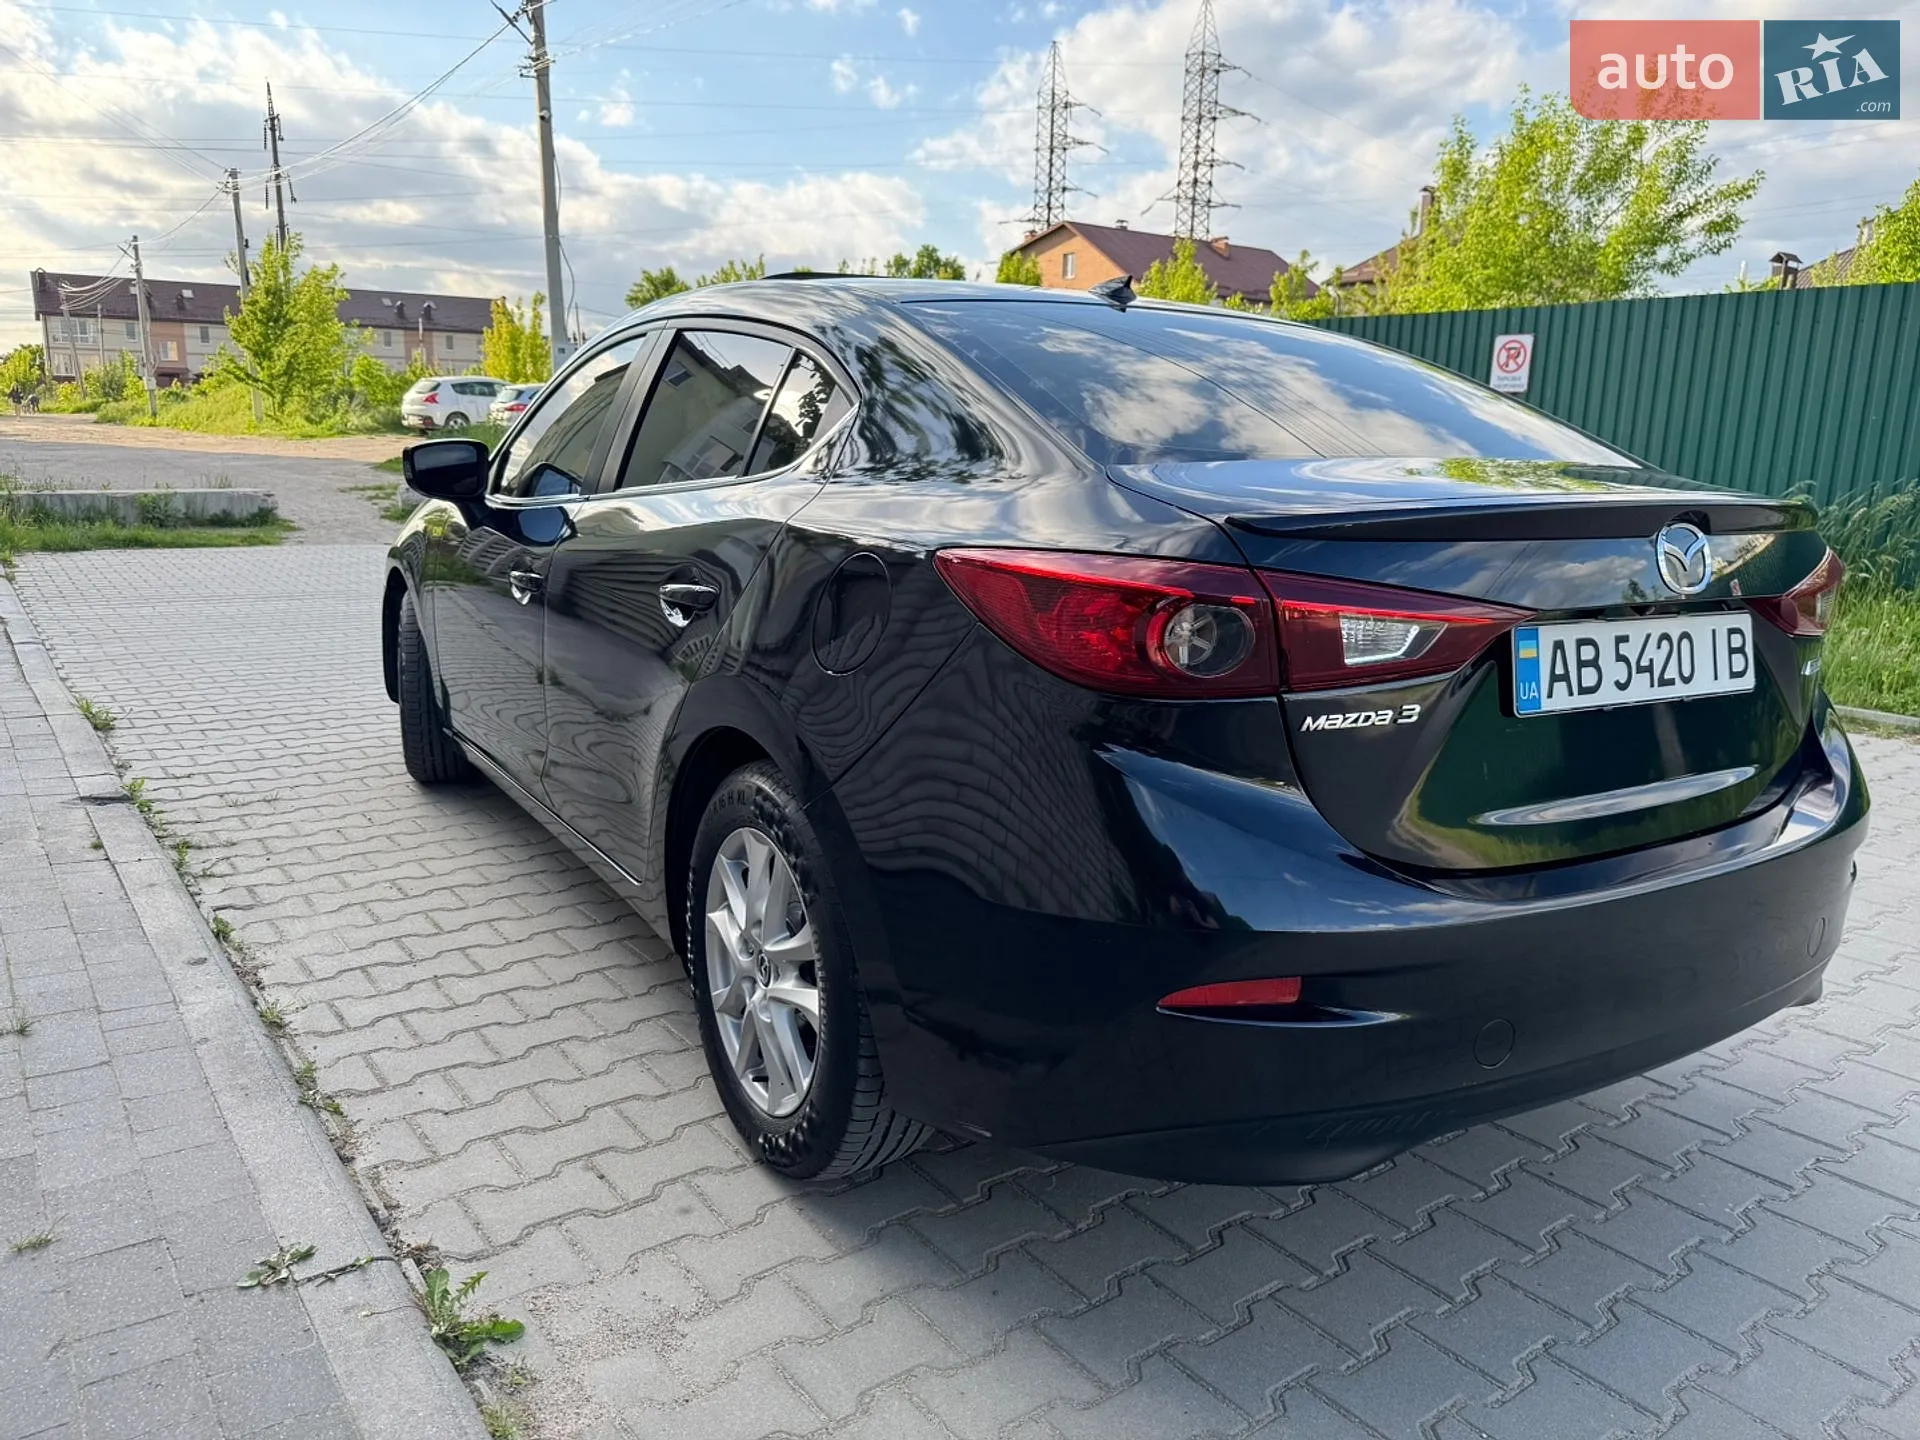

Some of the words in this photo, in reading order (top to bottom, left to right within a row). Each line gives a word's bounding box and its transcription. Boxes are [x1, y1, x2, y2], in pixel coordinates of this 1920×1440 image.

[1547, 637, 1603, 699] AB
[1613, 631, 1696, 691] 5420
[1712, 627, 1750, 682] IB
[1519, 682, 1539, 700] UA
[1396, 703, 1422, 724] 3
